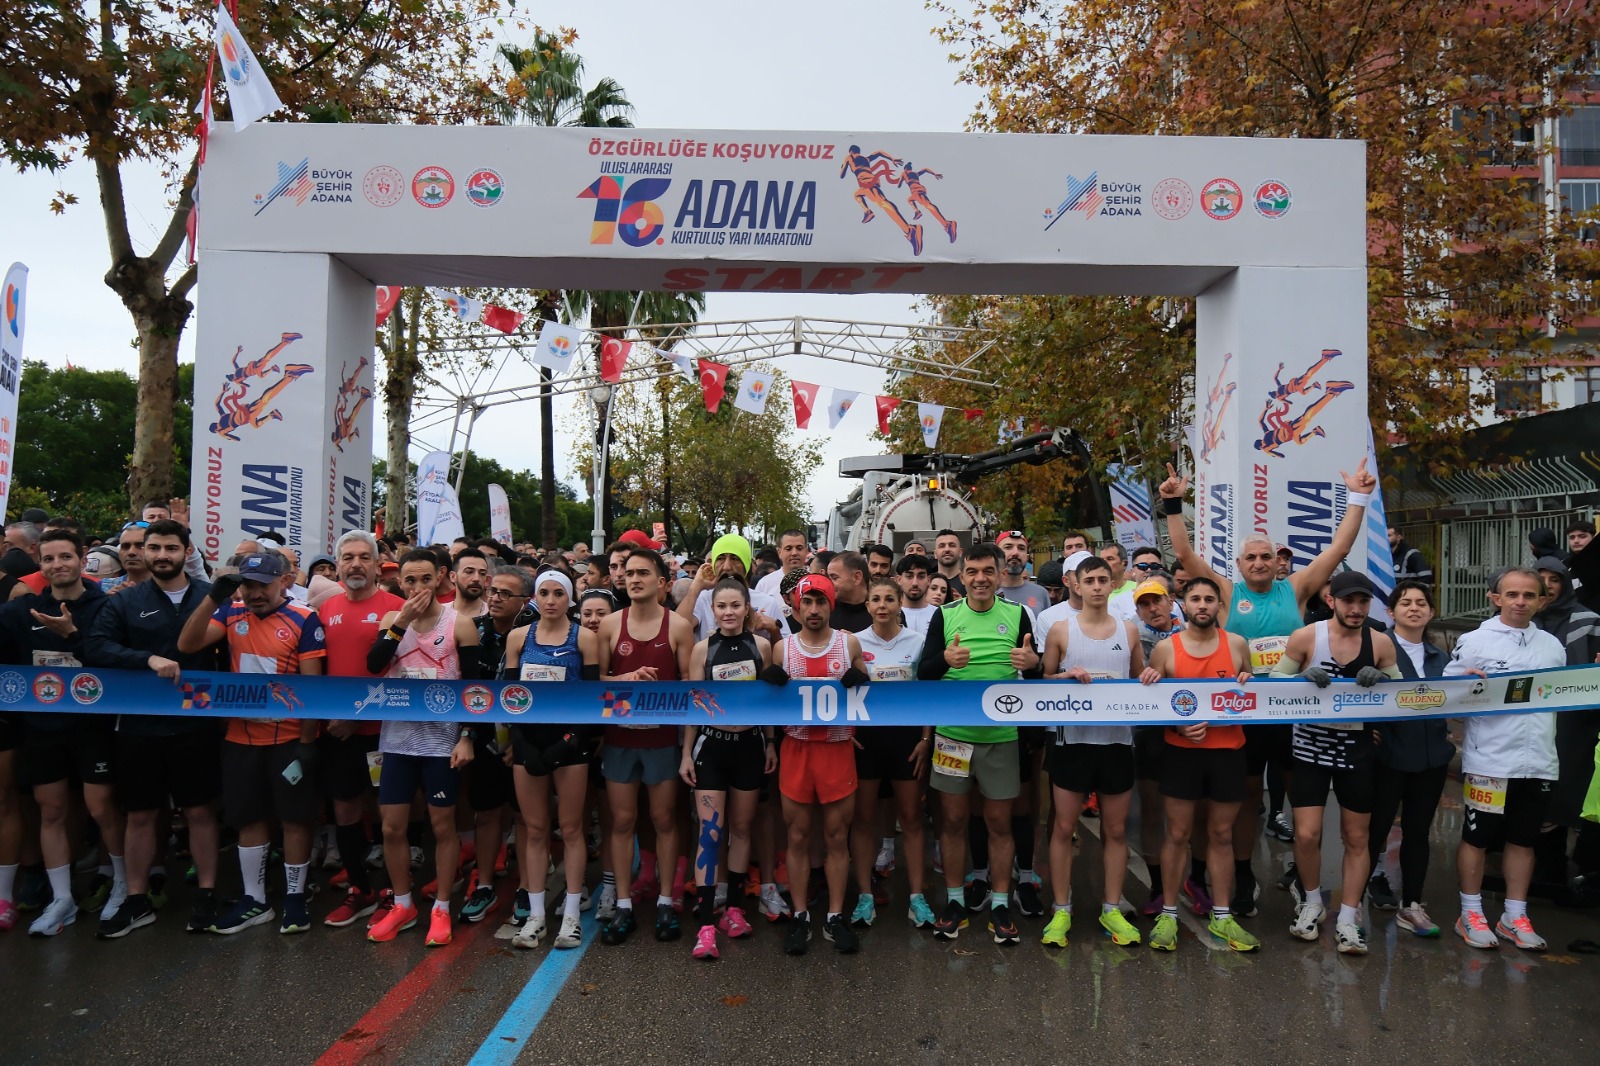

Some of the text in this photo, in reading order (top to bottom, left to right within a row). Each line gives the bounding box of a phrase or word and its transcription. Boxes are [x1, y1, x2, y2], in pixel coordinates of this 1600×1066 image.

[588, 138, 835, 162] ÖZGÜRLÜĞE KOŞUYORUZ
[312, 170, 352, 179] BÜYÜK
[600, 161, 673, 175] ULUSLARARASI
[316, 182, 352, 194] ŞEHİR
[1101, 183, 1142, 193] BÜYÜK
[311, 194, 352, 203] ADANA
[674, 179, 816, 229] ADANA
[1106, 195, 1142, 207] ŞEHİR
[1100, 207, 1142, 217] ADANA
[671, 230, 813, 246] KURTULUŞ YARI MARATONU
[661, 265, 926, 290] START
[290, 466, 303, 523] MARATONU
[205, 447, 224, 562] KOŞUYORUZ
[327, 456, 337, 555] OŞUYORUZ
[289, 524, 302, 547] YARI
[1211, 484, 1228, 578] DANA
[329, 613, 344, 627] VK
[1259, 652, 1284, 666] 153
[214, 684, 268, 704] ADANA
[1555, 683, 1600, 695] OPTIMUM
[634, 692, 689, 711] ADANA
[798, 685, 871, 722] 10 K
[1106, 703, 1159, 711] ACIBADEM
[1213, 694, 1253, 711] Dalga
[1268, 695, 1321, 706] Focawich
[1333, 690, 1388, 712] gizerler
[1399, 694, 1443, 704] MADENCİ
[706, 727, 740, 741] MOUR
[937, 753, 962, 769] 1772
[1469, 787, 1493, 804] 865
